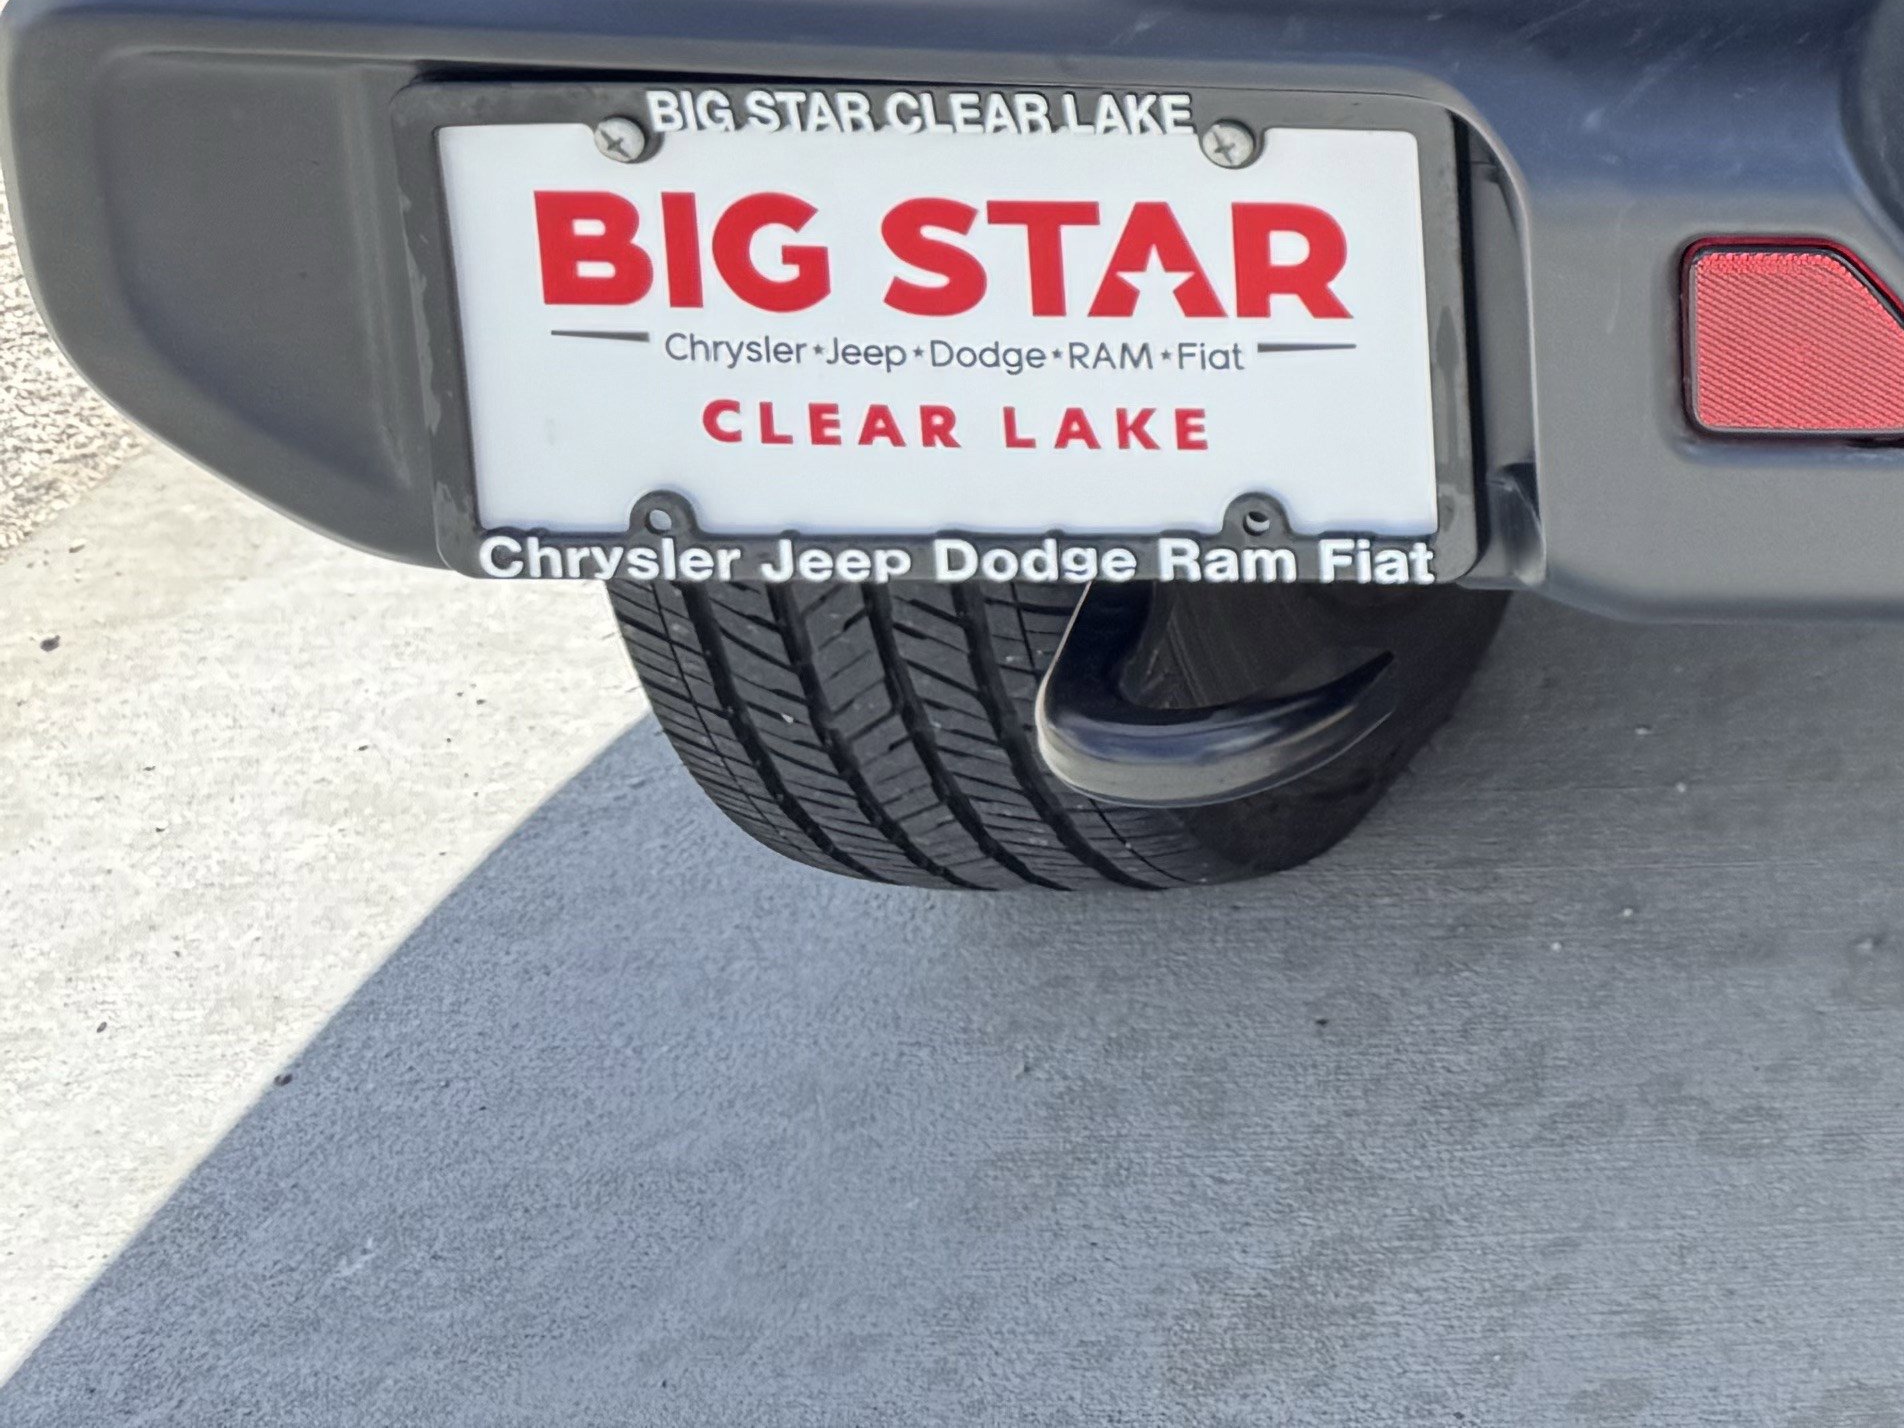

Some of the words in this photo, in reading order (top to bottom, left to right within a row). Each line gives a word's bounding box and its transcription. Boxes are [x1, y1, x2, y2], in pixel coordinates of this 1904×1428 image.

[646, 89, 736, 132] BIG
[746, 90, 875, 132] STAR
[886, 91, 1053, 134] CLEAR
[1061, 93, 1195, 136] LAKE
[534, 190, 831, 313] BIG
[881, 197, 1354, 319] STAR
[665, 333, 807, 369] Chrysler
[825, 336, 908, 373] Jeep
[929, 340, 1047, 375] Dodge
[1068, 342, 1154, 370] RAM
[1177, 342, 1245, 371] Fiat
[702, 399, 961, 448] CLEAR
[1003, 406, 1208, 450] LAKE
[479, 536, 741, 581] Chrysler
[760, 538, 911, 584] Jeep
[934, 538, 1137, 582] Dodge
[1157, 537, 1297, 584] Ram
[1317, 537, 1436, 585] Fiat
